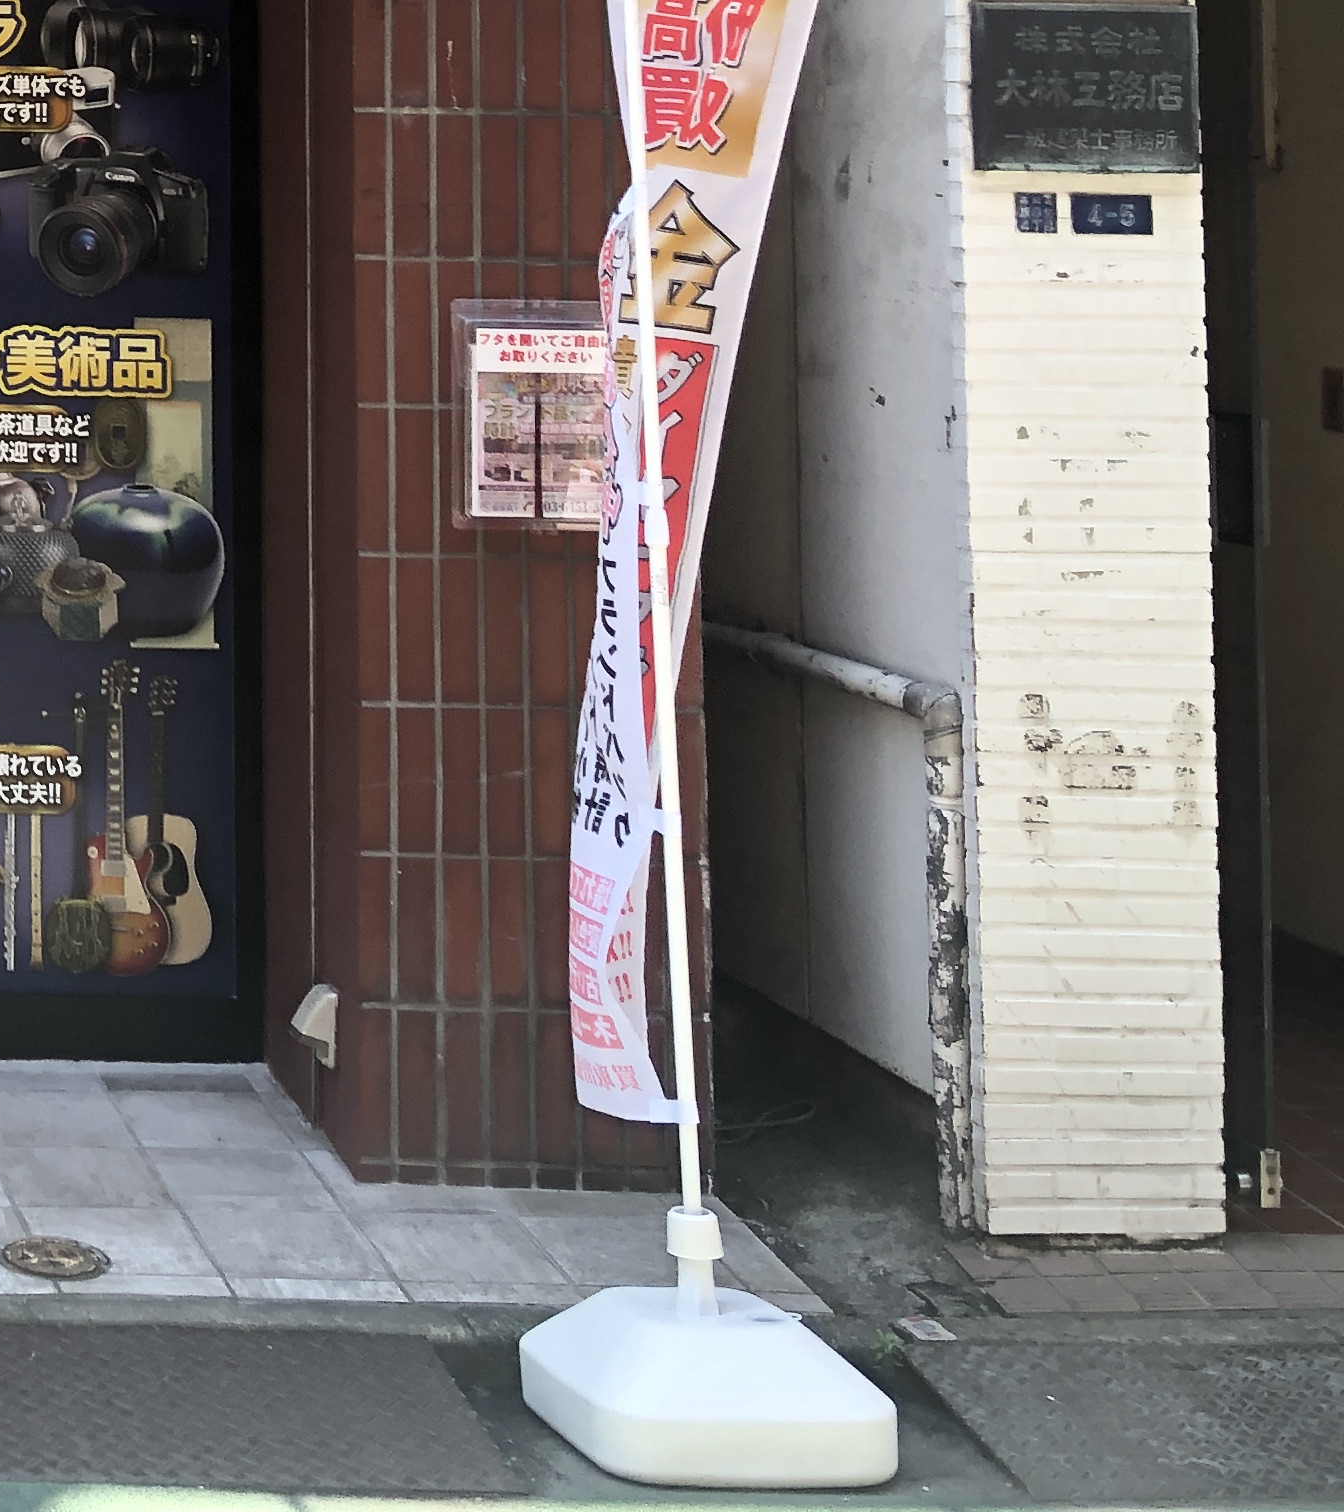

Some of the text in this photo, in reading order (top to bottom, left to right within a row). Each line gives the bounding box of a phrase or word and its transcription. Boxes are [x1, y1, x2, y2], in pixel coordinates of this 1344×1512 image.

[1014, 25, 1164, 59] 株式会社
[995, 68, 1184, 113] 大林工務店
[1087, 203, 1136, 228] 4-5
[499, 349, 593, 364] お取りください
